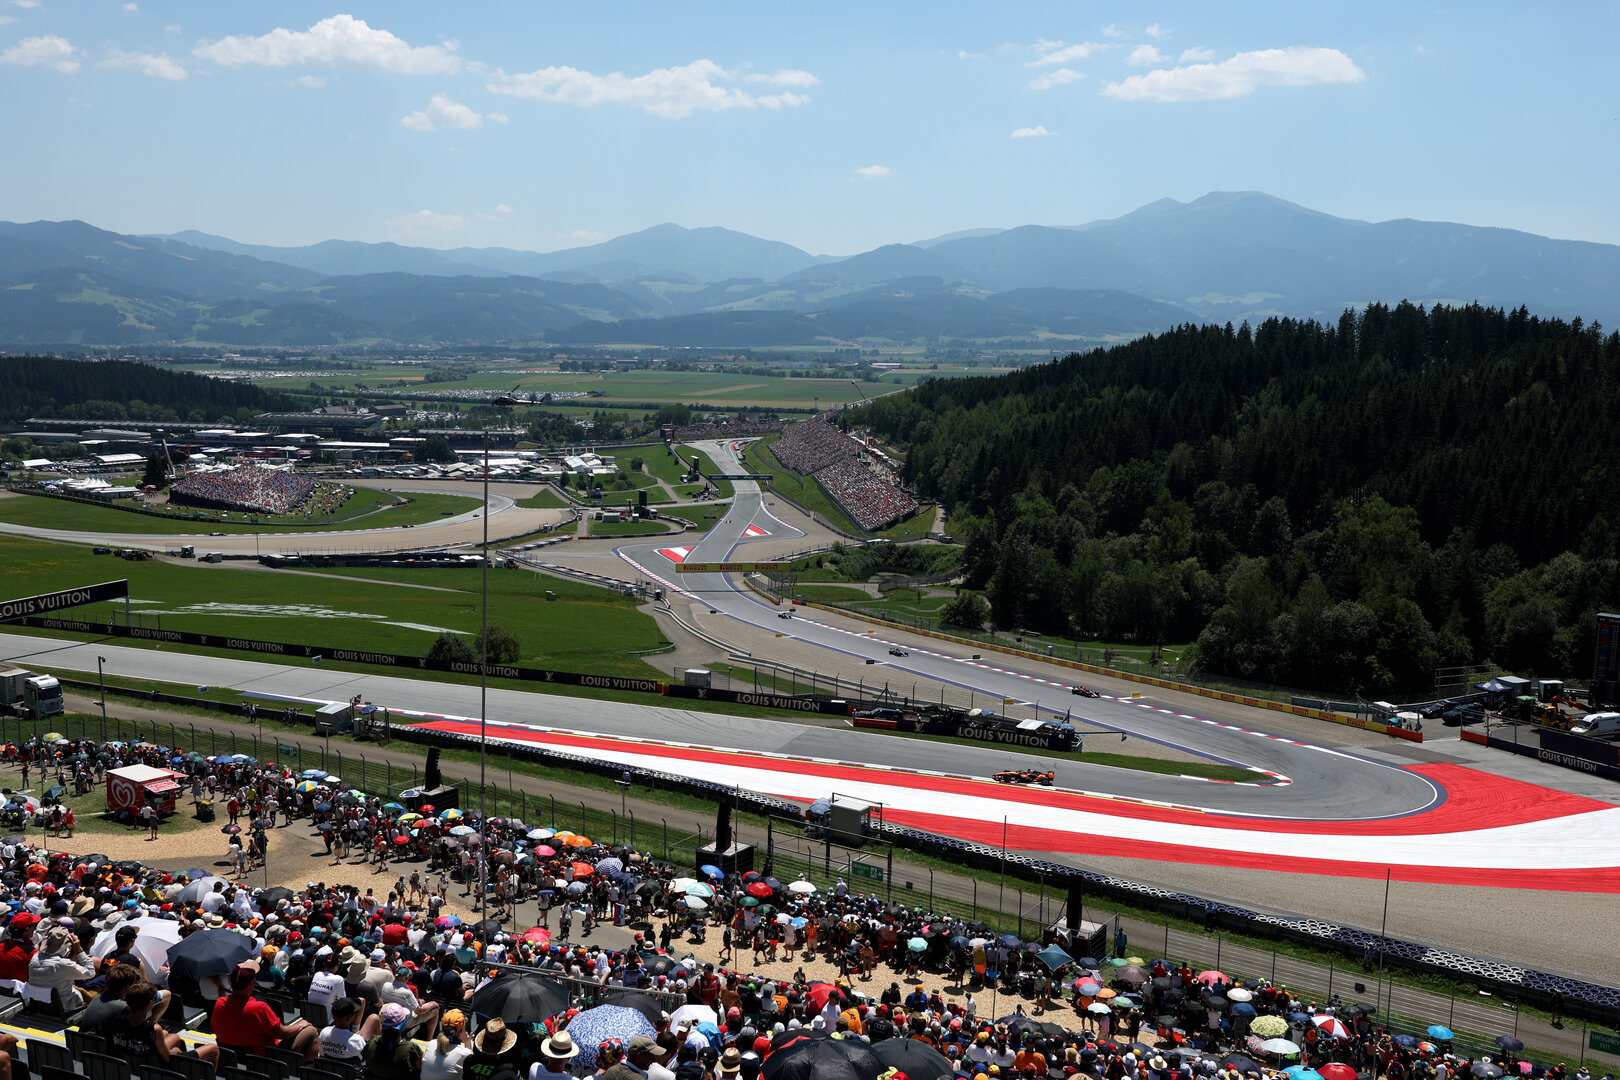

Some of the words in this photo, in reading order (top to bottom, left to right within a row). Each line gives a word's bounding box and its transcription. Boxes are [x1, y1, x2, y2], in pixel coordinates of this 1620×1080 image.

[0, 600, 34, 618] OUIS
[38, 590, 91, 610] VUITTON
[44, 619, 62, 629] LOUIS
[63, 621, 90, 631] VUITTON
[130, 628, 150, 638] LOUIS
[152, 630, 182, 640] VUITTON
[227, 639, 250, 649] LOUIS
[250, 642, 283, 652] VUITTON
[334, 650, 358, 660] LOUIS
[360, 653, 395, 664] VUITTON
[452, 662, 478, 672] LOUIS
[580, 675, 610, 687] LOUIS
[613, 678, 657, 691] VUITTON
[737, 694, 769, 706] LOUIS
[772, 697, 820, 711] VUITTON
[958, 727, 994, 740] LOUIS
[997, 732, 1049, 747] VUITTON
[1538, 750, 1560, 763] LOUIS
[1562, 756, 1597, 772] VUITTON
[470, 1064, 495, 1076] 46
